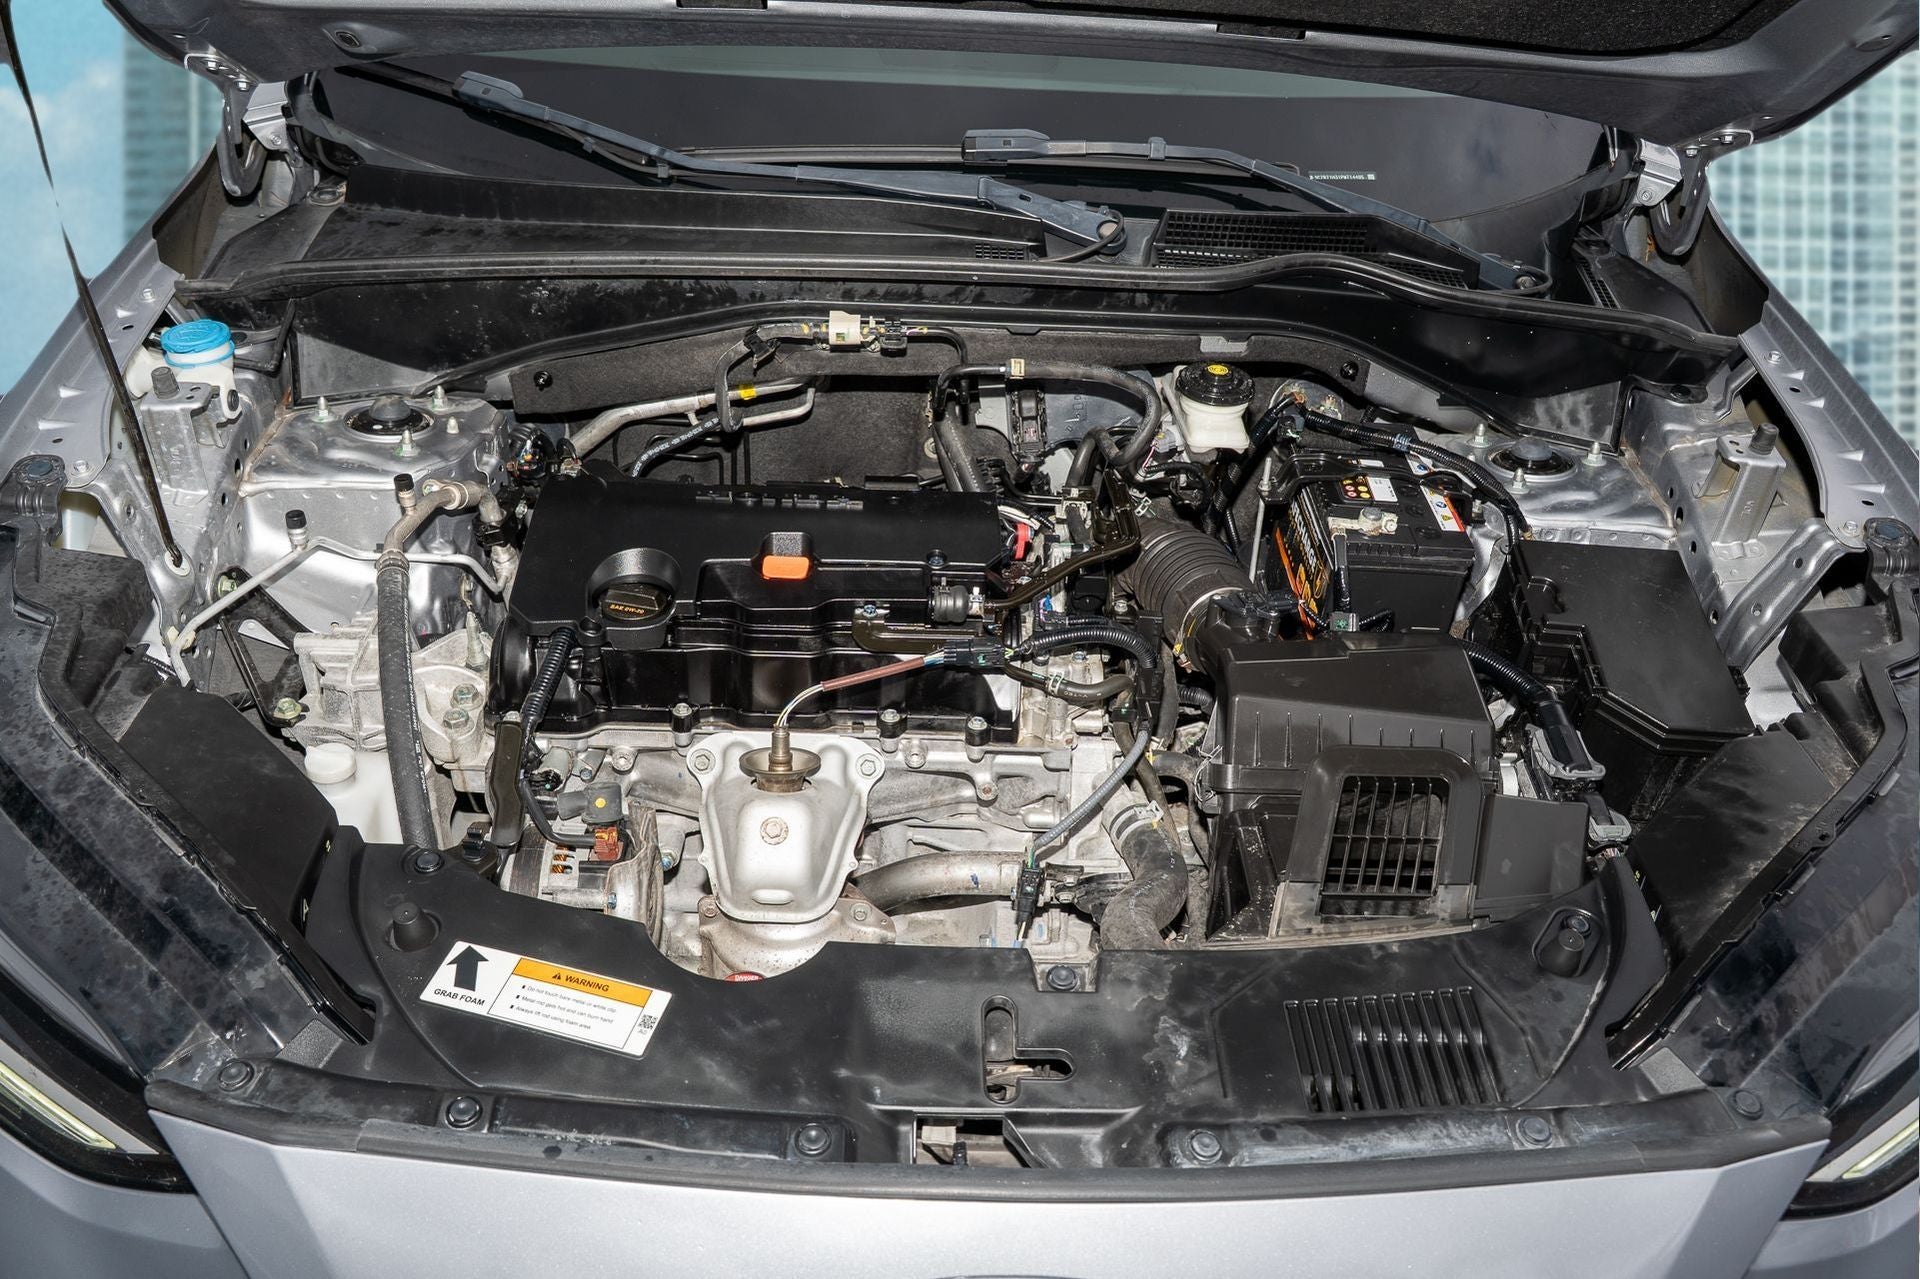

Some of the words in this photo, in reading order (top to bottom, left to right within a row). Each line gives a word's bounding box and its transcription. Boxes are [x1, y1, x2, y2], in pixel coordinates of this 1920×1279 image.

[624, 606, 645, 614] 0W-20
[565, 975, 610, 992] WARNING
[434, 988, 459, 999] GRAB
[460, 994, 485, 1006] FOAM
